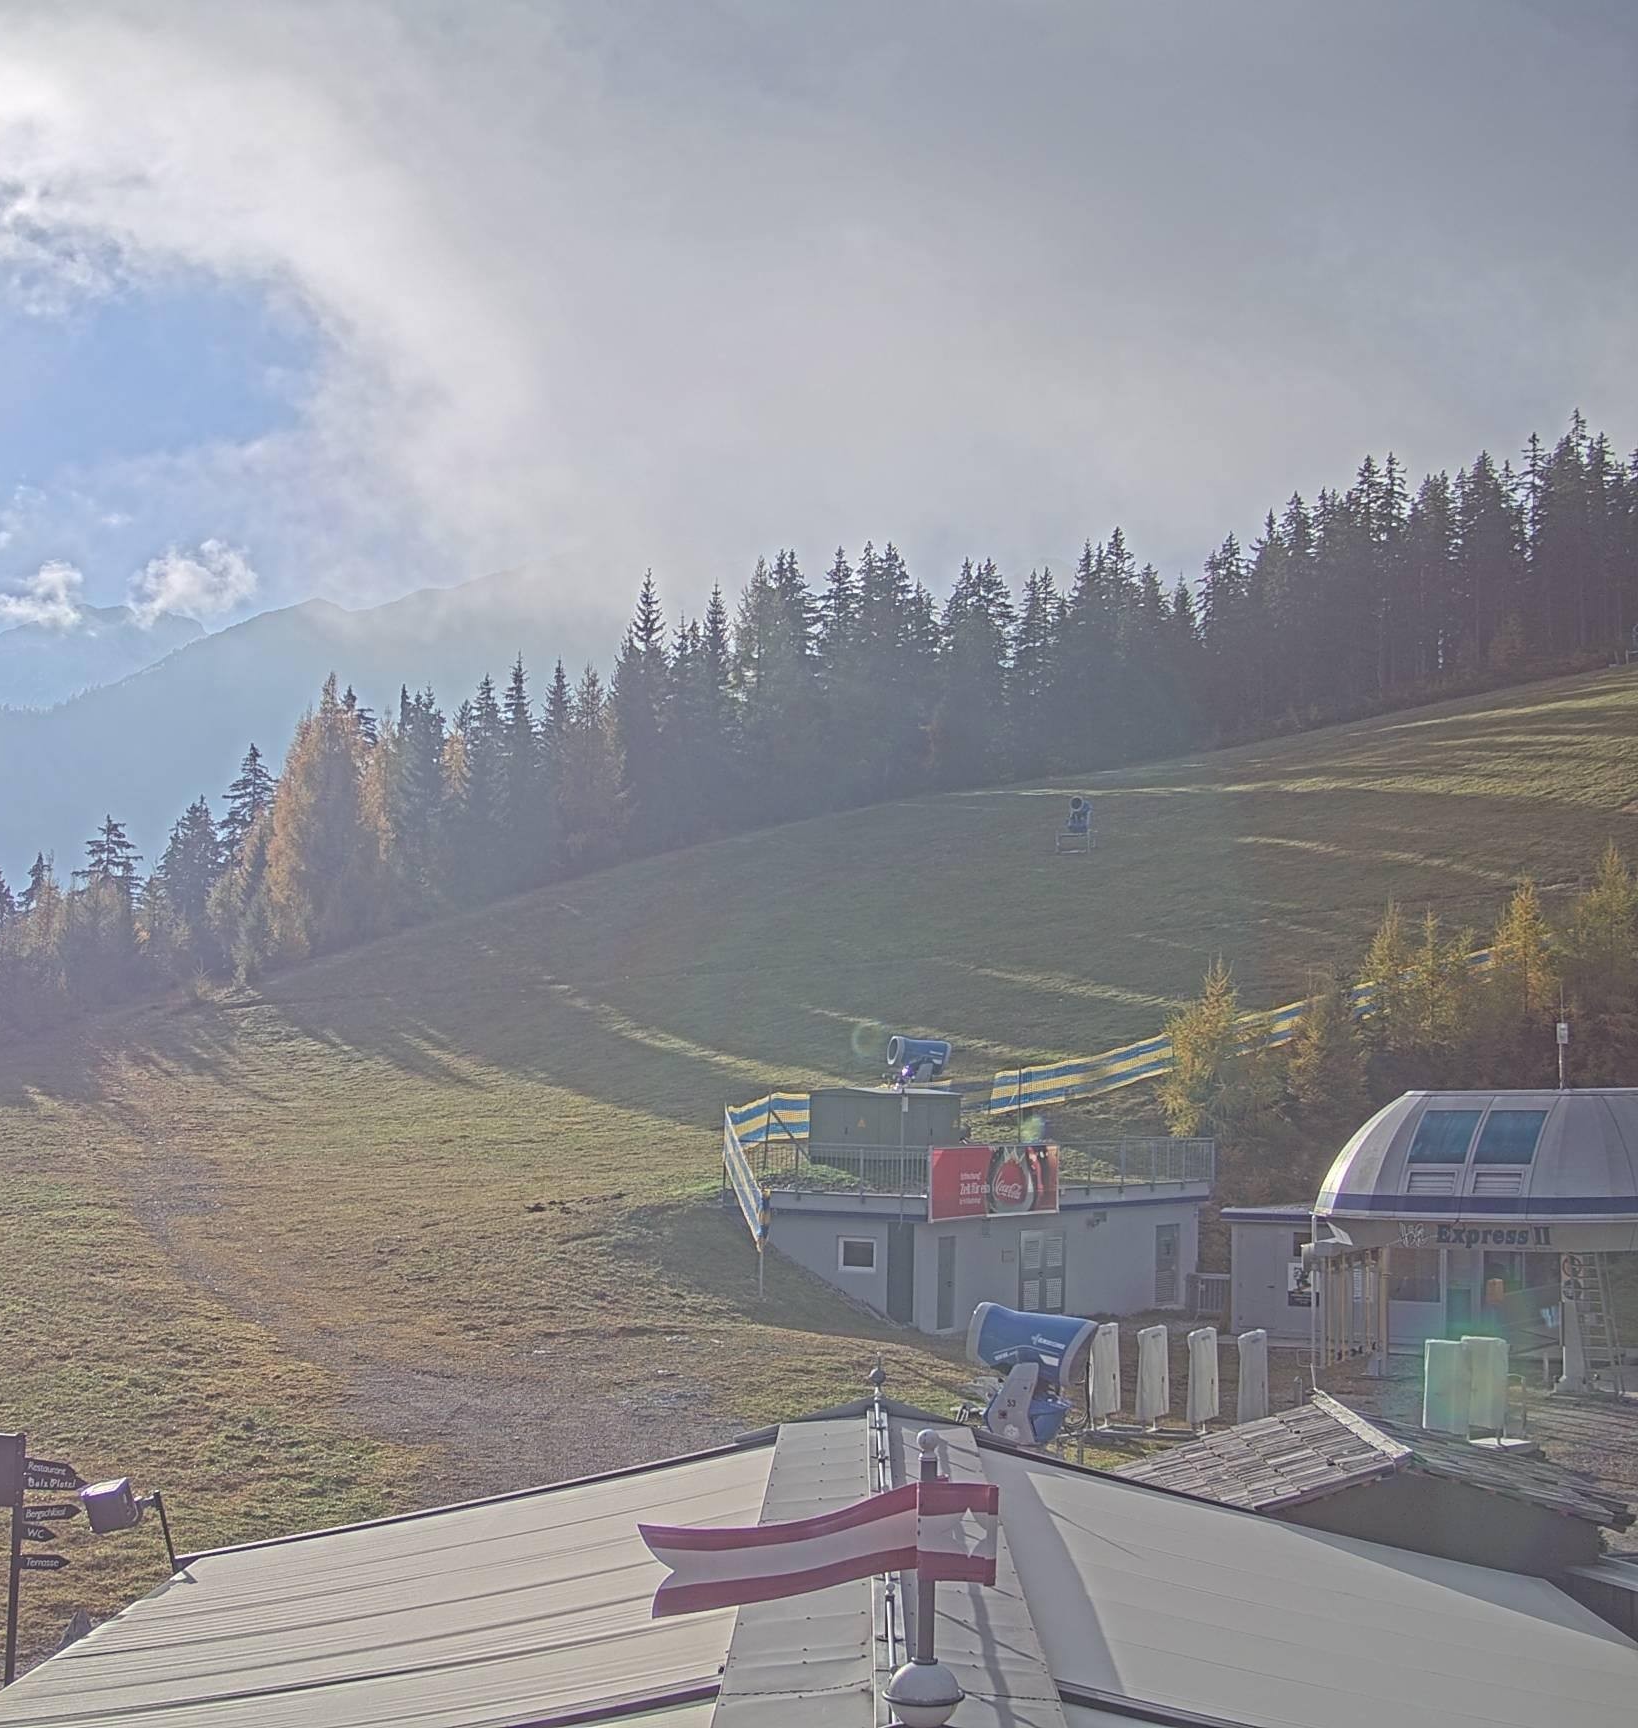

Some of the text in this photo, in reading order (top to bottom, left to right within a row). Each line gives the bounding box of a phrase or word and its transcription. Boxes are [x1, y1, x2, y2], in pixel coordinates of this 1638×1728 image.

[1436, 1223, 1529, 1248] Express
[28, 1461, 66, 1475] Restaurant
[27, 1528, 45, 1538] WC
[26, 1557, 60, 1567] Terrasse
